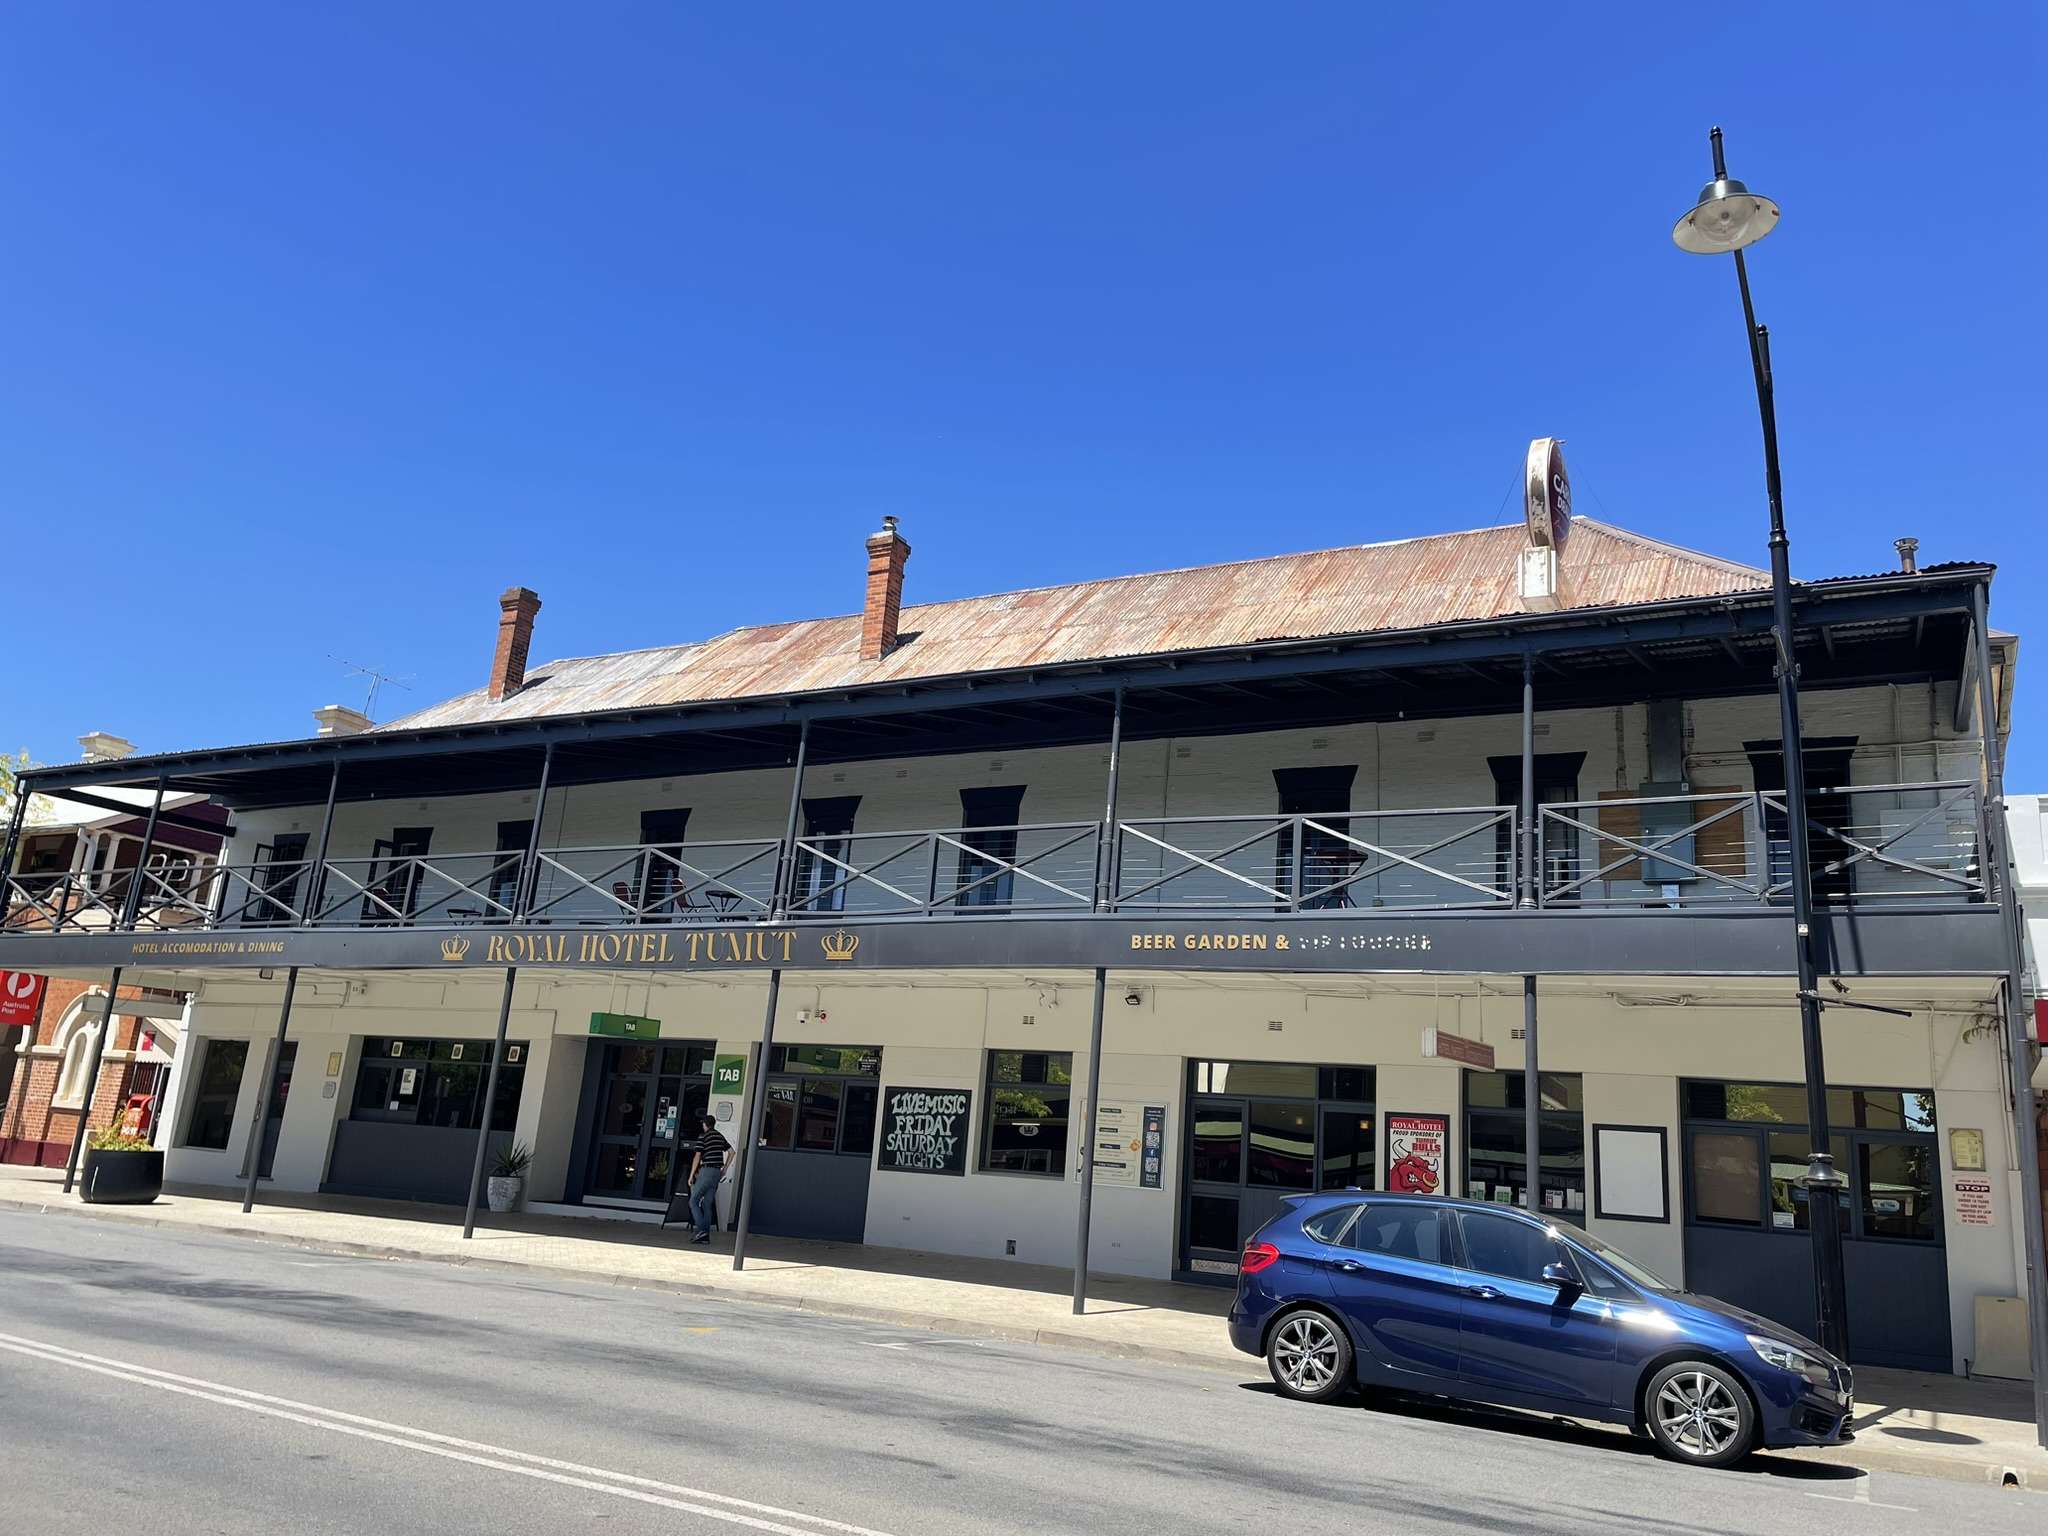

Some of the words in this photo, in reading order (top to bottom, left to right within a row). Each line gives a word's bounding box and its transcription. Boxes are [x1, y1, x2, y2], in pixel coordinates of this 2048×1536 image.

[132, 943, 159, 954] HOTEL
[162, 942, 234, 953] ACCOMODATION
[237, 942, 245, 953] &
[248, 942, 285, 953] DINING
[486, 934, 571, 962] ROYAL
[579, 933, 675, 962] HOTEL
[686, 931, 797, 962] TUMUT
[1131, 934, 1176, 950] BEER
[1184, 934, 1268, 950] GARDEN
[1275, 934, 1291, 950] &
[1, 1007, 16, 1015] Post
[3, 1001, 30, 1010] Australia
[625, 1023, 636, 1031] TAB
[719, 1069, 740, 1082] TAB
[894, 1114, 956, 1136] FRIDAY
[886, 1133, 959, 1156] SATURDAY
[1412, 1143, 1441, 1152] BULLS
[895, 1151, 945, 1169] NIGHTS
